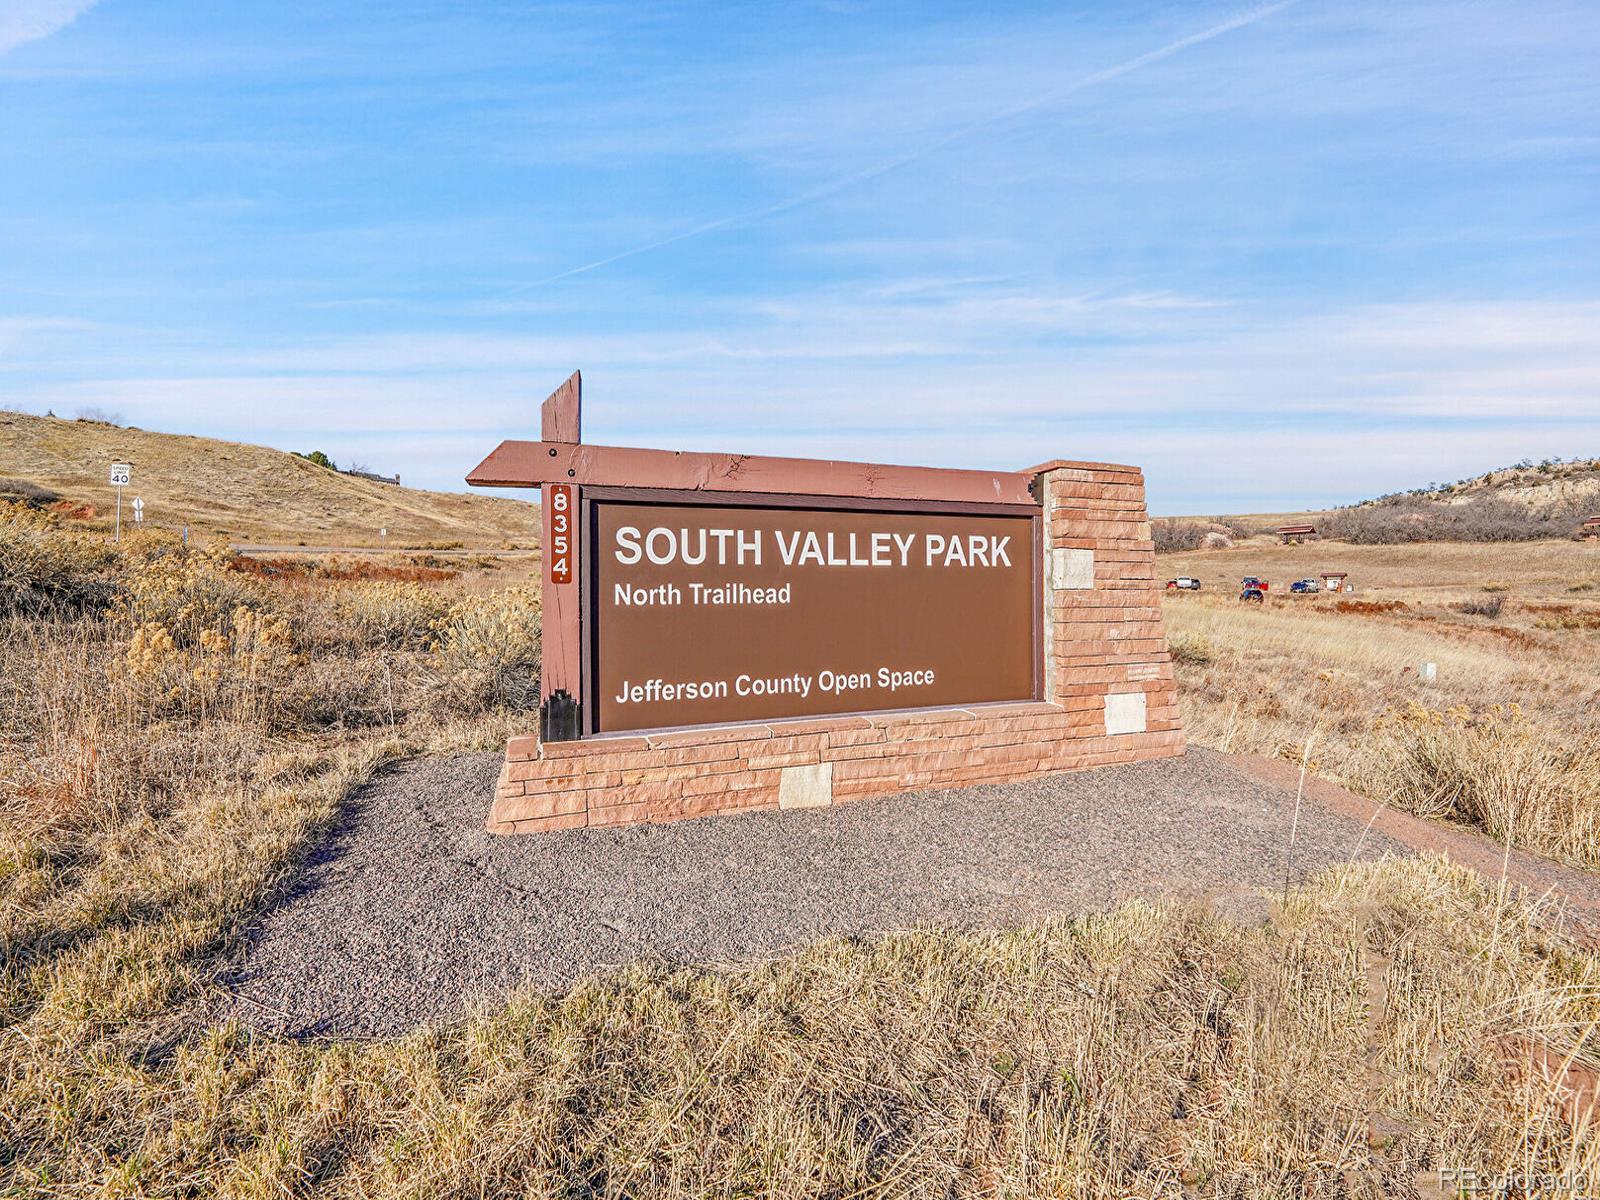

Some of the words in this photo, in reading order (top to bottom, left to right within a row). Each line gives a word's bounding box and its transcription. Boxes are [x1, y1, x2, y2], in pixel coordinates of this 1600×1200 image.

[112, 475, 129, 483] 40
[552, 492, 569, 576] 8354
[614, 526, 763, 566] SOUTH
[774, 530, 916, 567] VALLEY
[925, 533, 1012, 567] PARK
[614, 583, 682, 606] North
[688, 582, 792, 605] Trailhead
[615, 678, 728, 704] Jefferson
[735, 672, 813, 699] County
[818, 669, 872, 696] Open
[877, 666, 935, 692] Space
